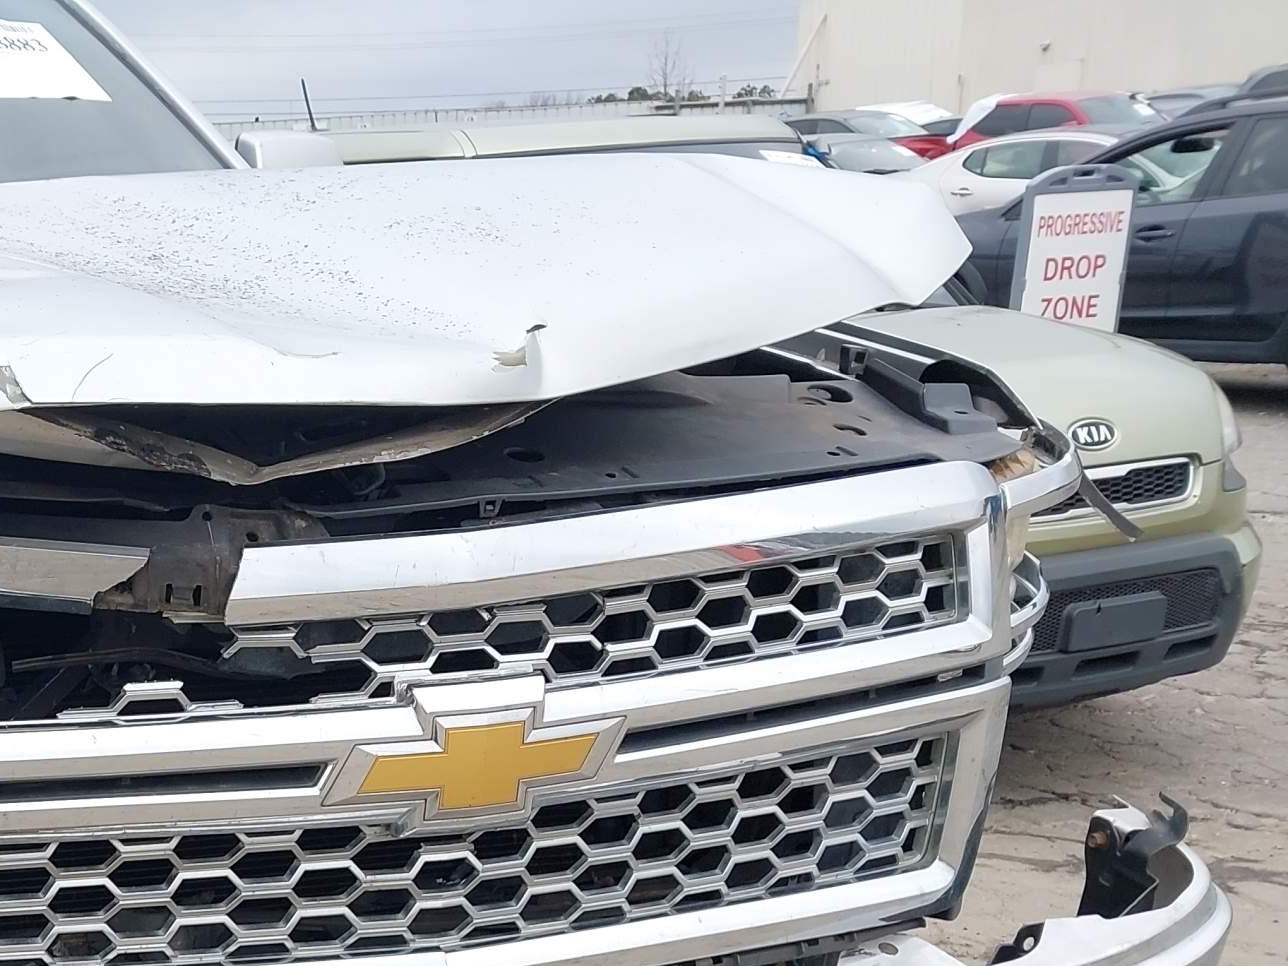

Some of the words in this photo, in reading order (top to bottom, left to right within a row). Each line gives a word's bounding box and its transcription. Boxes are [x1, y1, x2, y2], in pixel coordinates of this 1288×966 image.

[1037, 211, 1125, 238] PROGRESSIVE
[1043, 254, 1106, 281] DROP
[1040, 294, 1100, 320] ZONE
[1076, 425, 1112, 444] KIA
